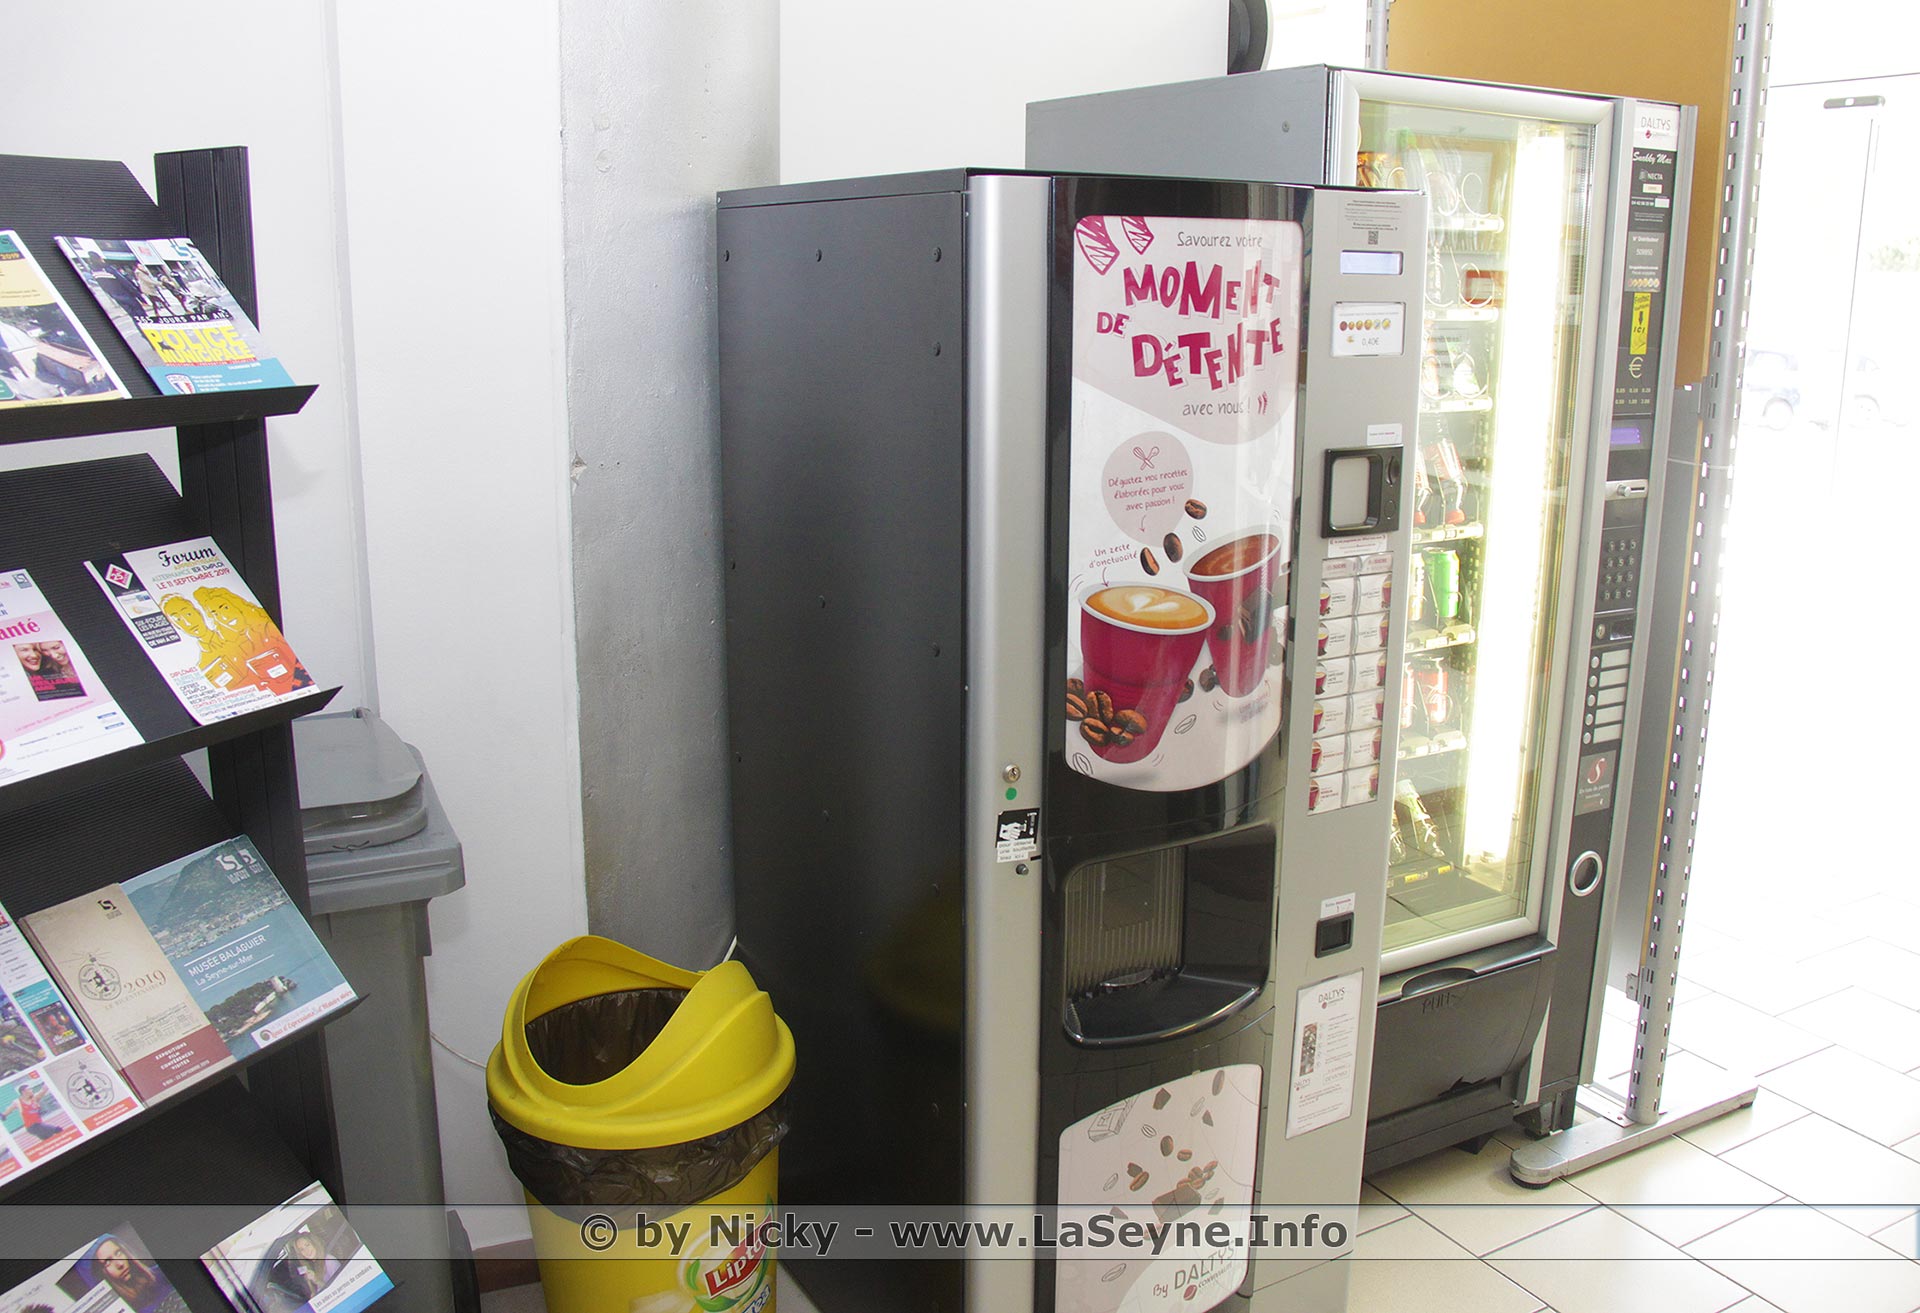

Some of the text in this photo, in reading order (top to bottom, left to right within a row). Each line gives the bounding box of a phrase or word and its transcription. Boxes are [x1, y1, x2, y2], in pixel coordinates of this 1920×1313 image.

[1641, 116, 1671, 131] DALTYS
[1177, 231, 1262, 247] Savourez votre
[1123, 260, 1280, 319] MOMENT
[134, 315, 154, 324] 365
[159, 316, 187, 324] JOURS
[191, 313, 210, 322] PAR
[1096, 311, 1129, 335] DE
[142, 325, 244, 351] POLICE
[1361, 337, 1380, 346] 0,40€
[157, 343, 256, 364] MUNICIPALE
[1132, 317, 1283, 390] DÉTENTE
[1182, 402, 1213, 416] avec
[1218, 401, 1243, 414] nous
[1108, 469, 1188, 488] Dégustez nos recettes
[1114, 483, 1184, 499] élaborées pour vous
[1126, 502, 1143, 511] avec
[1145, 497, 1171, 511] passion
[158, 547, 217, 567] Forum
[1089, 550, 1138, 568] d'onctuosité
[1094, 543, 1131, 557] Un zeste
[202, 562, 225, 571] EMPLOI
[156, 581, 167, 590] LE
[173, 572, 214, 587] SEPTEMBRE
[214, 568, 231, 577] 2019
[188, 934, 267, 977] MUSÉE BALAGUIER
[194, 954, 254, 986] La Seyne-sur-Mer
[123, 969, 167, 993] 2019
[1318, 986, 1345, 1003] DALTYS
[155, 1042, 187, 1060] EXPOSITIONS
[1153, 1240, 1234, 1298] By DALTYS
